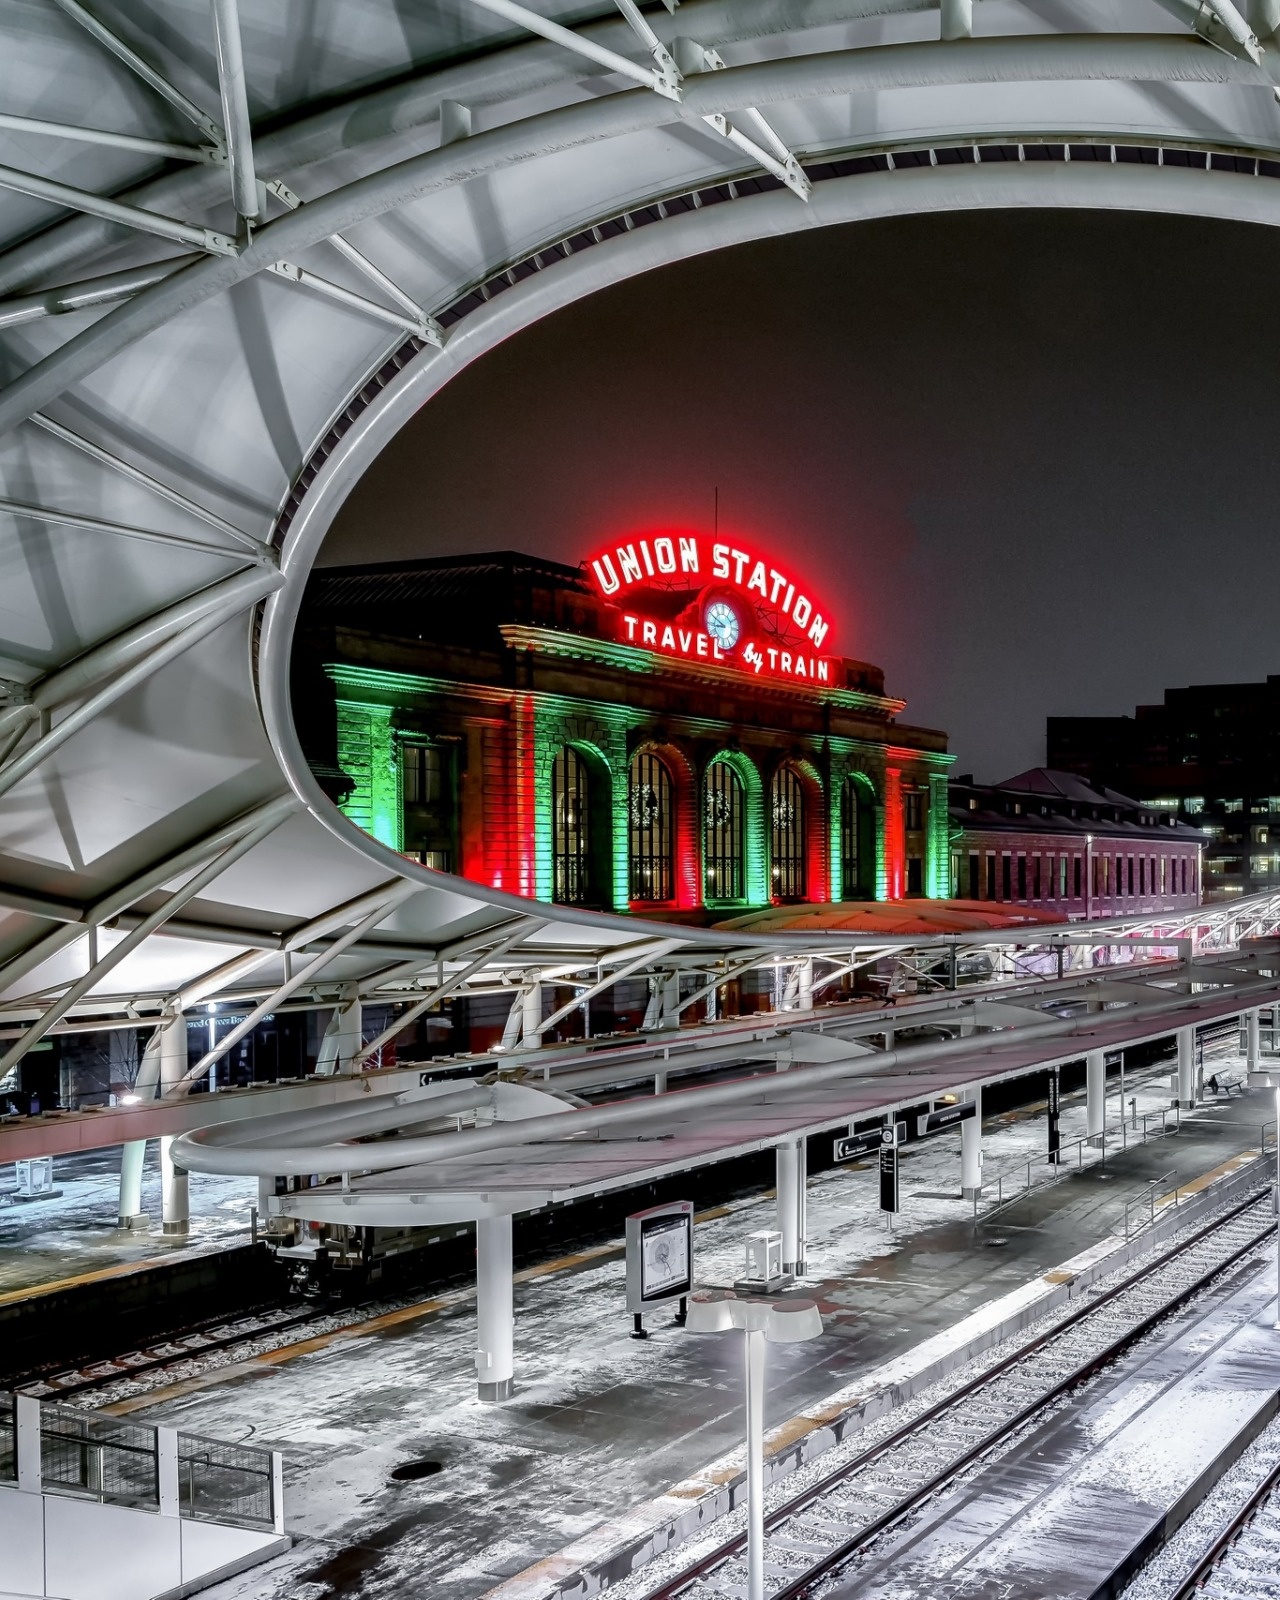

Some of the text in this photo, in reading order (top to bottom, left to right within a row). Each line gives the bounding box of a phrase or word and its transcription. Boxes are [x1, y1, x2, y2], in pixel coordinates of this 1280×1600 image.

[592, 538, 828, 648] UNION STATION
[624, 616, 828, 681] TRAVEL by TRAIN
